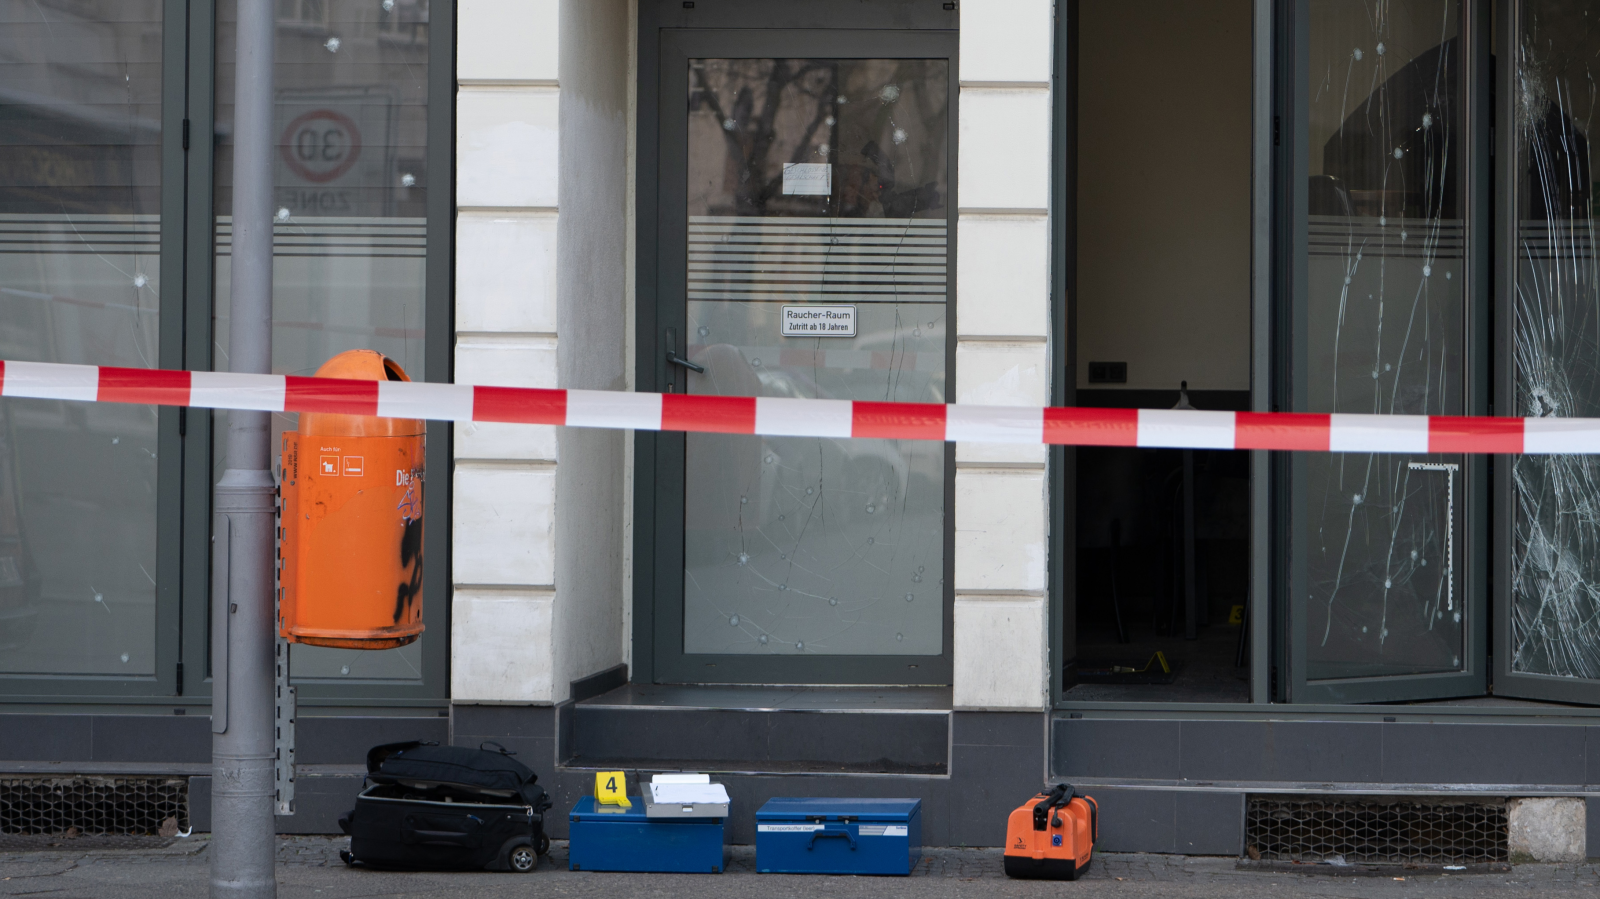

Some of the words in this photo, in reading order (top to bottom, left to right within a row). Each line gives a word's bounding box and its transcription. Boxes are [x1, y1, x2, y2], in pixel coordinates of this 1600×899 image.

[787, 310, 851, 319] Raucher-Raum
[827, 323, 849, 331] Jahren
[396, 469, 410, 487] Die
[605, 776, 618, 793] 4
